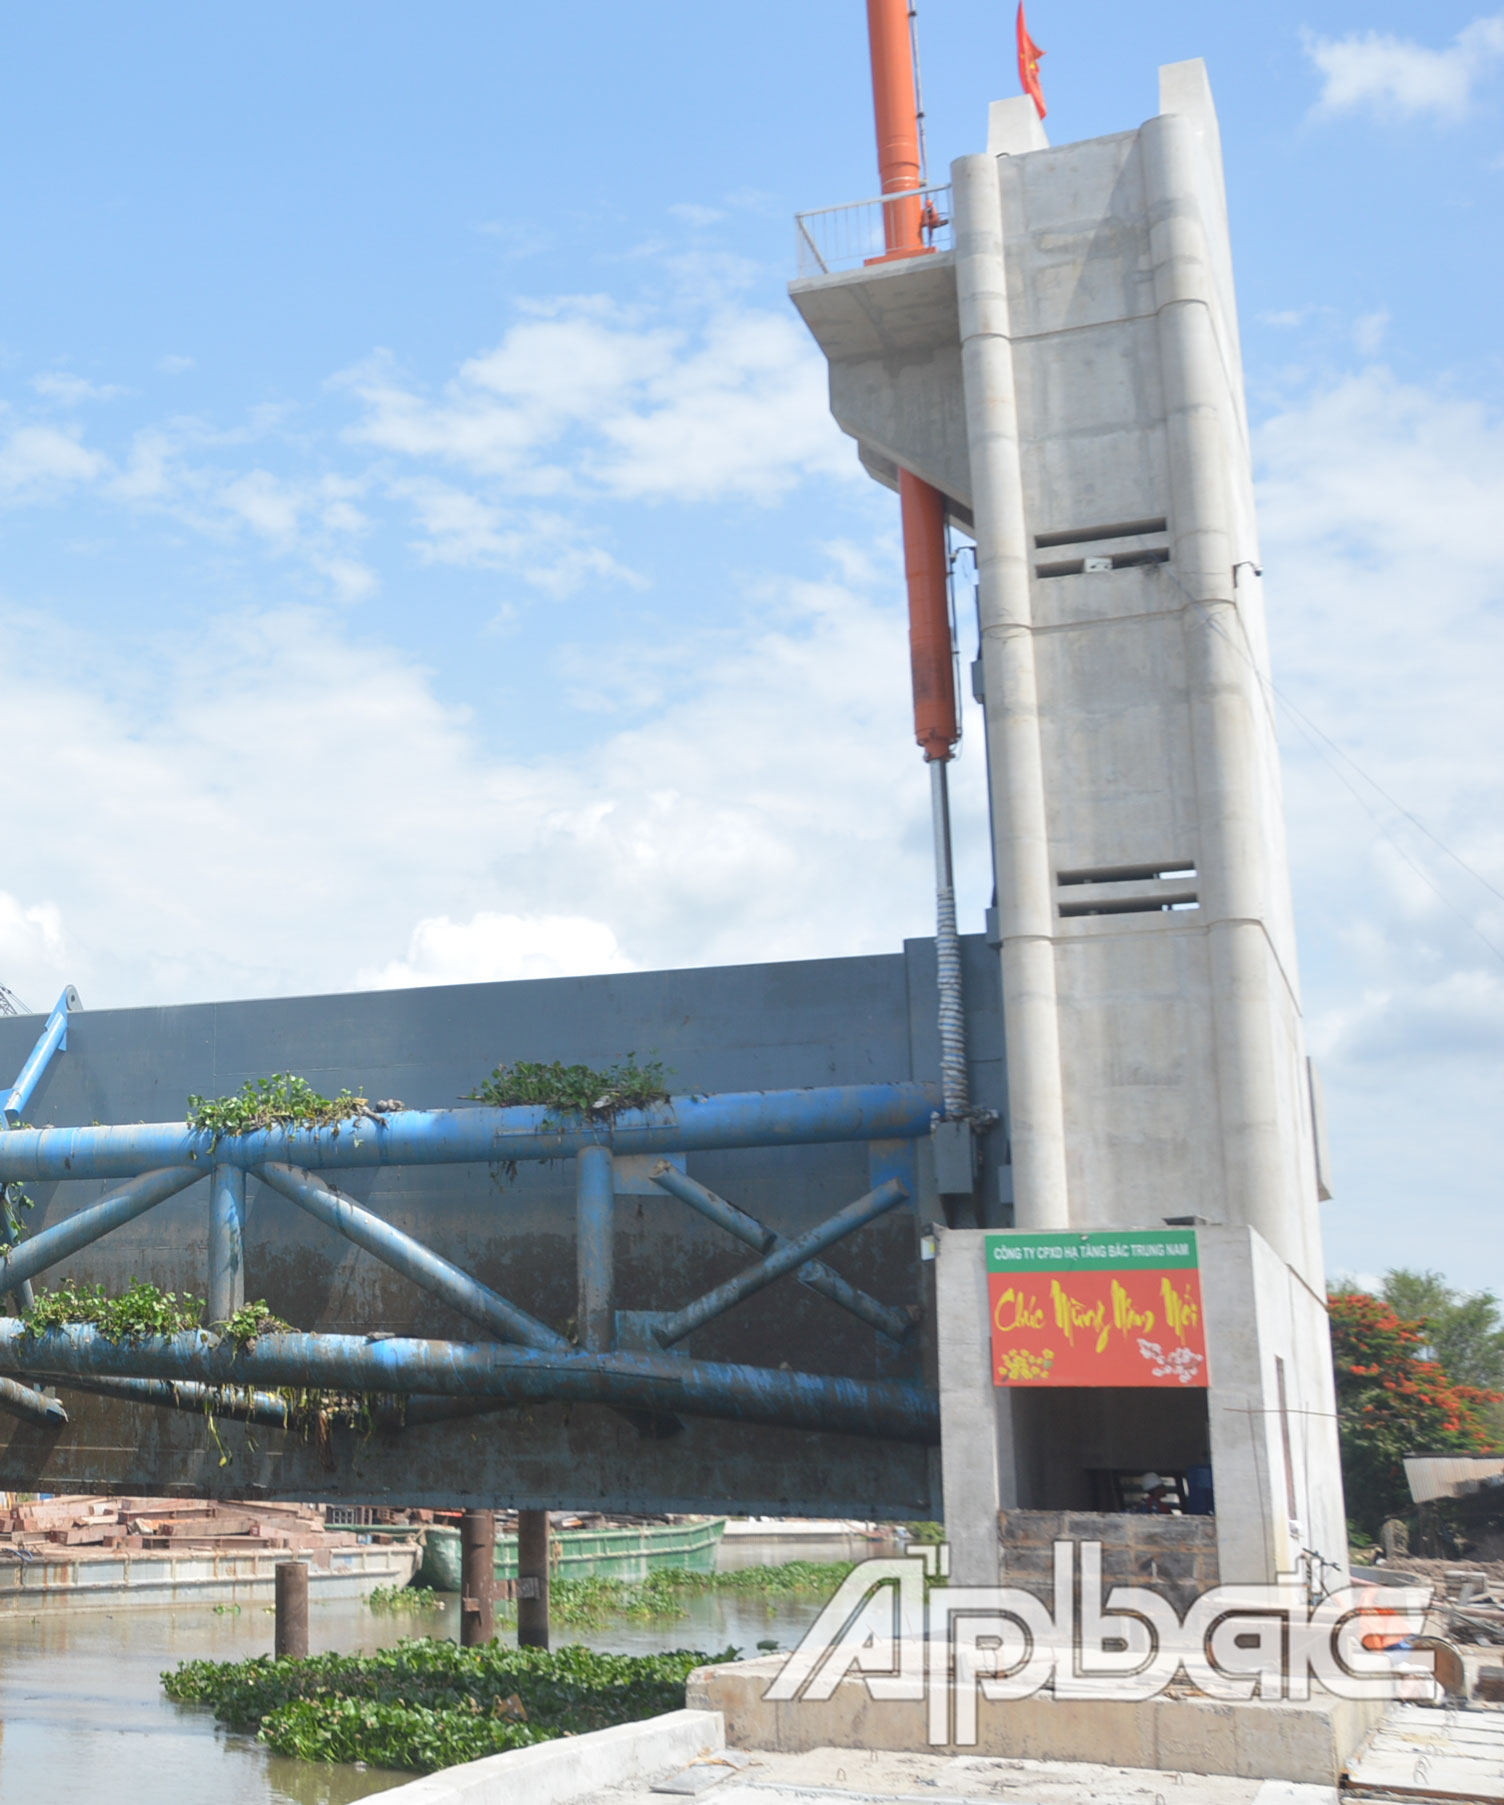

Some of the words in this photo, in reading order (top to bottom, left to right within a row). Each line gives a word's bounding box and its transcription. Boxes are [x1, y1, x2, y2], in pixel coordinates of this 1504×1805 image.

[993, 1244, 1022, 1260] CÔNG
[1023, 1247, 1035, 1260] TY
[1131, 1244, 1165, 1257] TRUNG
[1166, 1243, 1189, 1256] NAM
[994, 1288, 1045, 1332] Chúc
